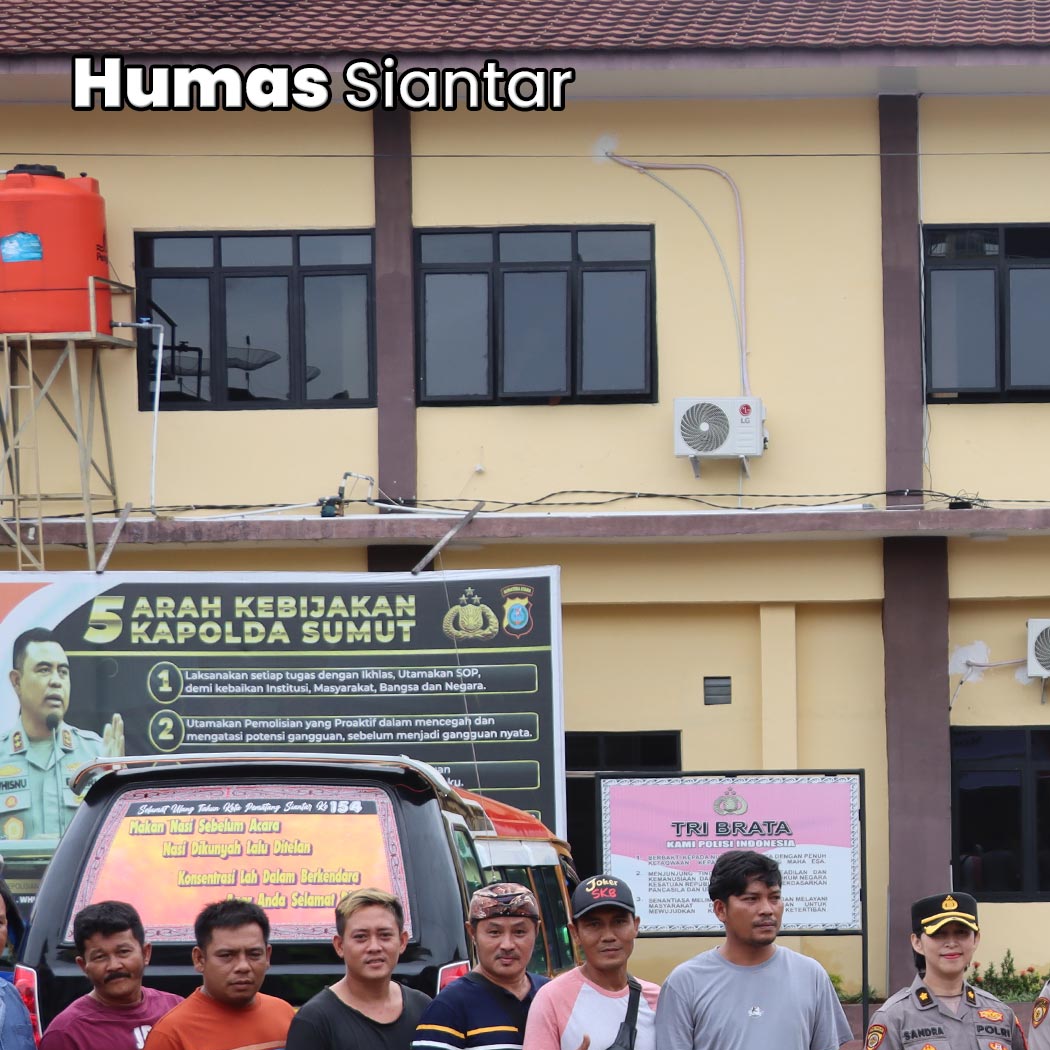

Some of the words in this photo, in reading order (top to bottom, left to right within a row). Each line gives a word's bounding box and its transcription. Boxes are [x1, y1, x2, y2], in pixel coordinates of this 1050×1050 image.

[130, 596, 222, 618] ARAH
[235, 594, 417, 618] KEBIJAKAN
[83, 595, 126, 644] 5
[130, 620, 291, 644] KAPOLDA
[302, 619, 417, 643] SUMUT
[156, 669, 173, 692] 1
[185, 671, 249, 681] Laksanakan
[250, 670, 284, 683] setiap
[285, 672, 316, 683] tugas
[318, 670, 359, 682] dengan
[361, 669, 396, 680] Ikhlas,
[398, 669, 454, 679] Utamakan
[456, 668, 481, 679] SOP,
[185, 684, 212, 693] demi
[215, 684, 263, 693] kebaikan
[266, 683, 311, 695] Institusi,
[313, 684, 377, 695] Masyarakat,
[379, 683, 420, 694] Bangsa
[421, 682, 442, 691] dan
[445, 681, 487, 693] Negara.
[158, 717, 174, 740] 2
[186, 719, 242, 728] Utamakan
[244, 718, 303, 728] Pemolisian
[305, 720, 332, 731] yang
[334, 717, 377, 728] Proaktif
[379, 717, 413, 727] dalam
[415, 716, 472, 728] mencegah
[474, 716, 495, 725] dan
[186, 732, 244, 742] mengatasi
[246, 731, 286, 742] potensi
[288, 732, 346, 743] gangguan,
[347, 730, 394, 740] sebelum
[396, 729, 440, 741] menjadi
[442, 730, 498, 742] gangguan
[500, 729, 533, 740] nyata.
[330, 800, 363, 814] 154
[129, 819, 165, 835] Makan
[169, 818, 194, 834] Nasi
[198, 818, 245, 834] Sebelum
[249, 818, 281, 833] Acara
[671, 820, 709, 837] TRI
[714, 820, 793, 837] BRATA
[162, 841, 188, 857] Nasi
[191, 840, 243, 860] Dikunyah
[246, 840, 270, 857] Lalu
[273, 839, 312, 856] Ditelan
[665, 840, 697, 849] KAMI
[698, 839, 735, 849] POLISI
[736, 838, 797, 848] INDONESIA
[177, 869, 238, 887] Konsentrasi
[240, 869, 260, 886] Lah
[262, 868, 296, 886] Dalam
[300, 868, 362, 886] Berkendara
[257, 891, 287, 909] Anda
[291, 891, 337, 909] Selamat
[903, 1027, 945, 1041] SANDRA
[976, 1024, 1012, 1038] POLRI
